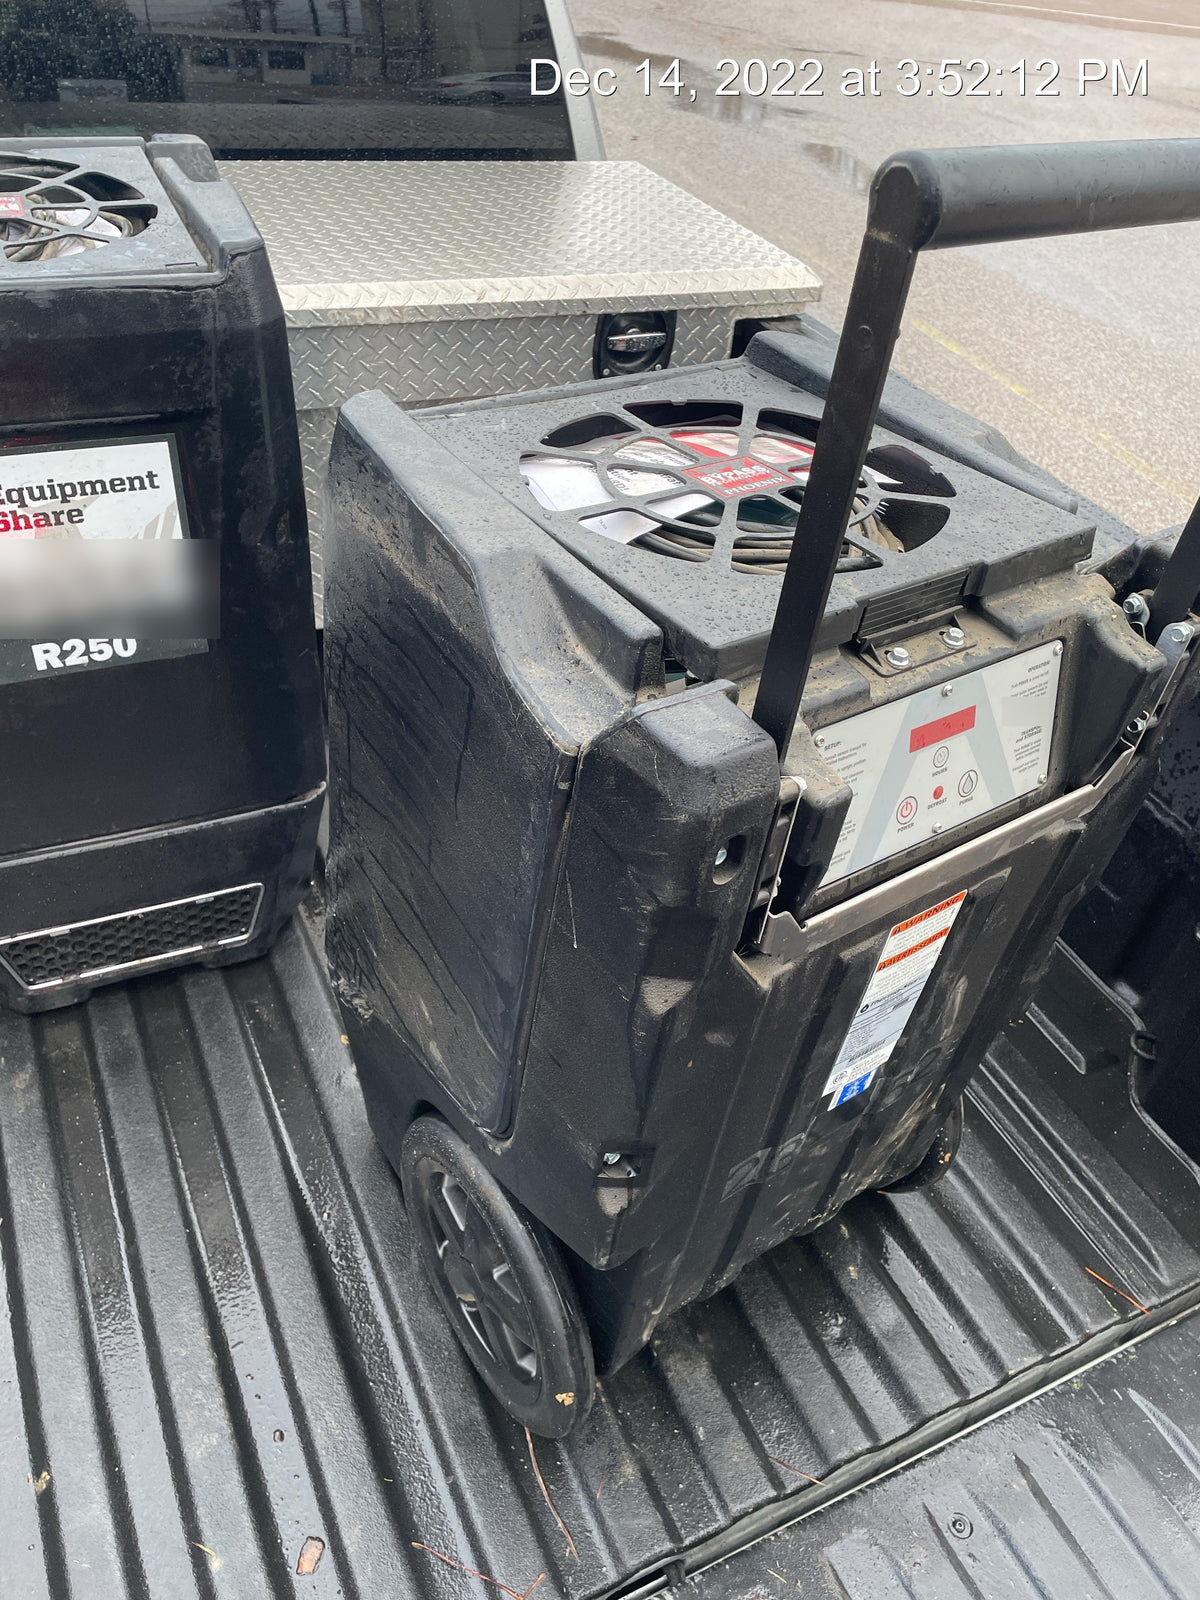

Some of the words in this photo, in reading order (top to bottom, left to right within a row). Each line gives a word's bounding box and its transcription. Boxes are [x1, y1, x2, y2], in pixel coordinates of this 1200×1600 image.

[698, 464, 768, 486] BYPASS
[724, 476, 787, 495] PHOENIX
[31, 638, 137, 671] R250
[931, 766, 948, 777] HOURS
[927, 797, 948, 810] DEFROST
[897, 822, 915, 834] POWER
[905, 895, 960, 926] WARNING
